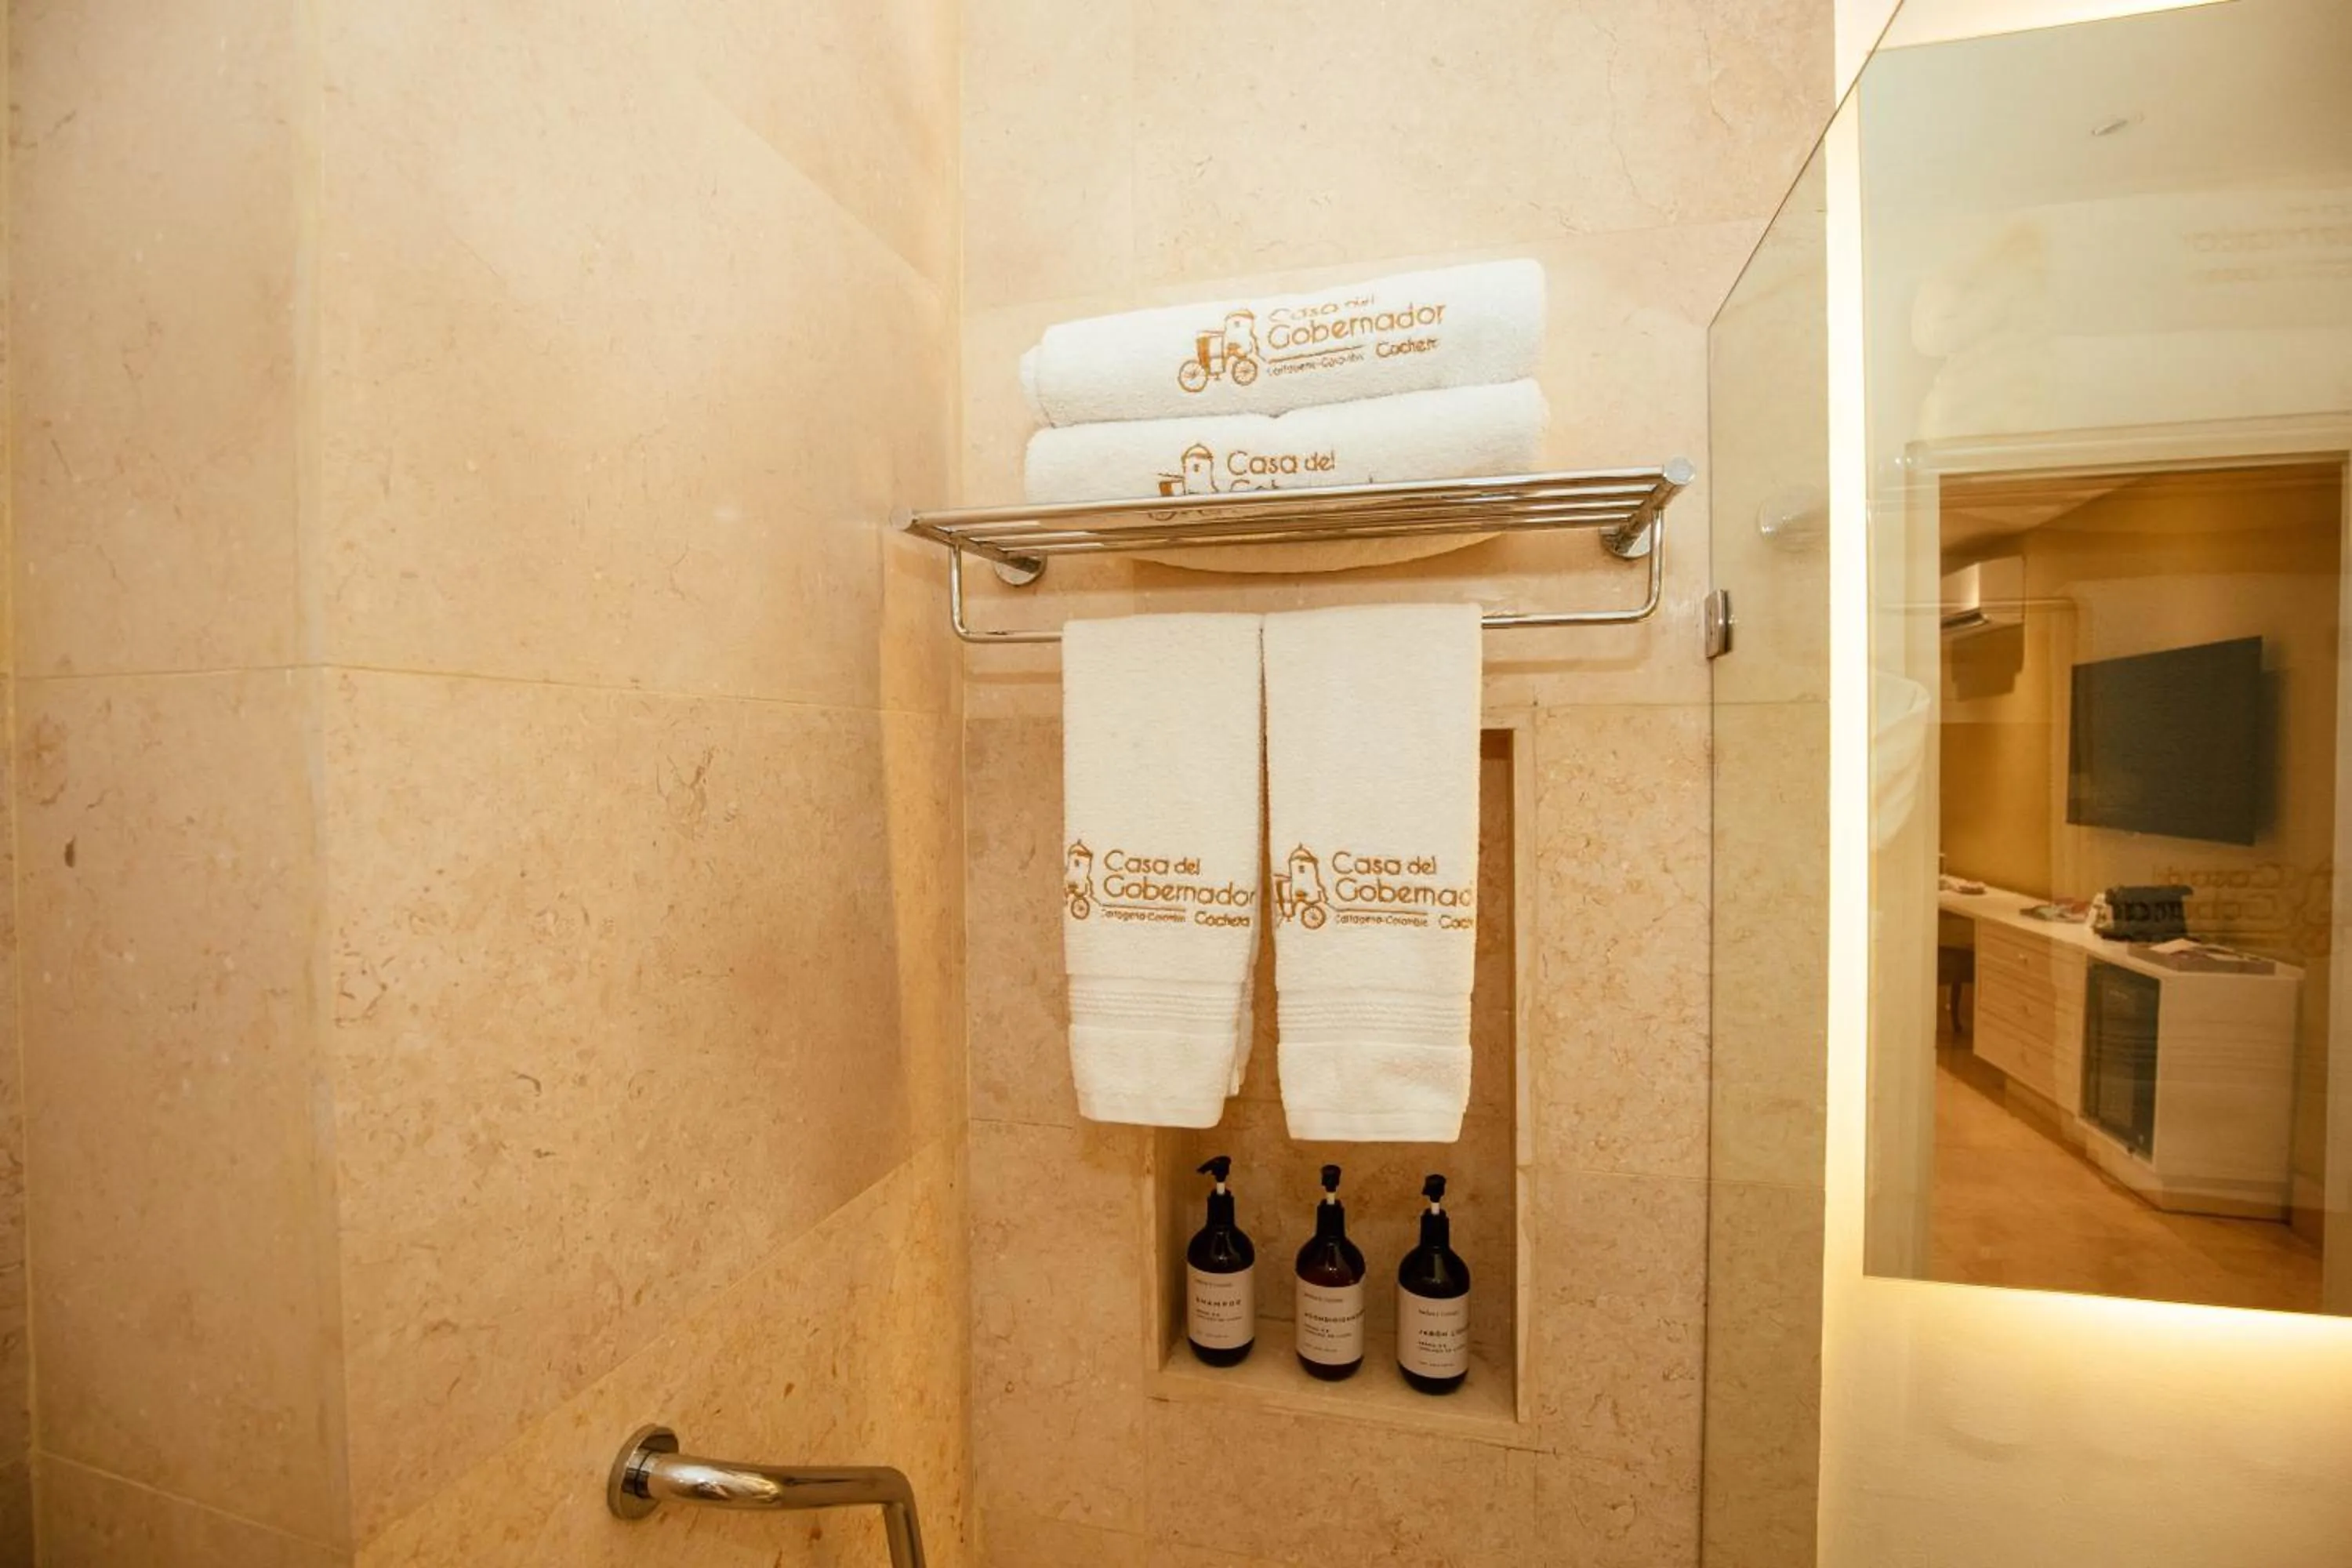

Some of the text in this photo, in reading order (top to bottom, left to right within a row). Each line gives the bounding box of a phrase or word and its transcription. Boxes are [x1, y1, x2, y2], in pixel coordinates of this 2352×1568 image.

[1268, 303, 1339, 322] Casa
[1267, 303, 1446, 350] Gobernador
[1227, 450, 1336, 476] Casa del
[1103, 848, 1203, 875] Casa del
[1332, 851, 1437, 876] Casa del
[1103, 874, 1256, 907] Gobernador
